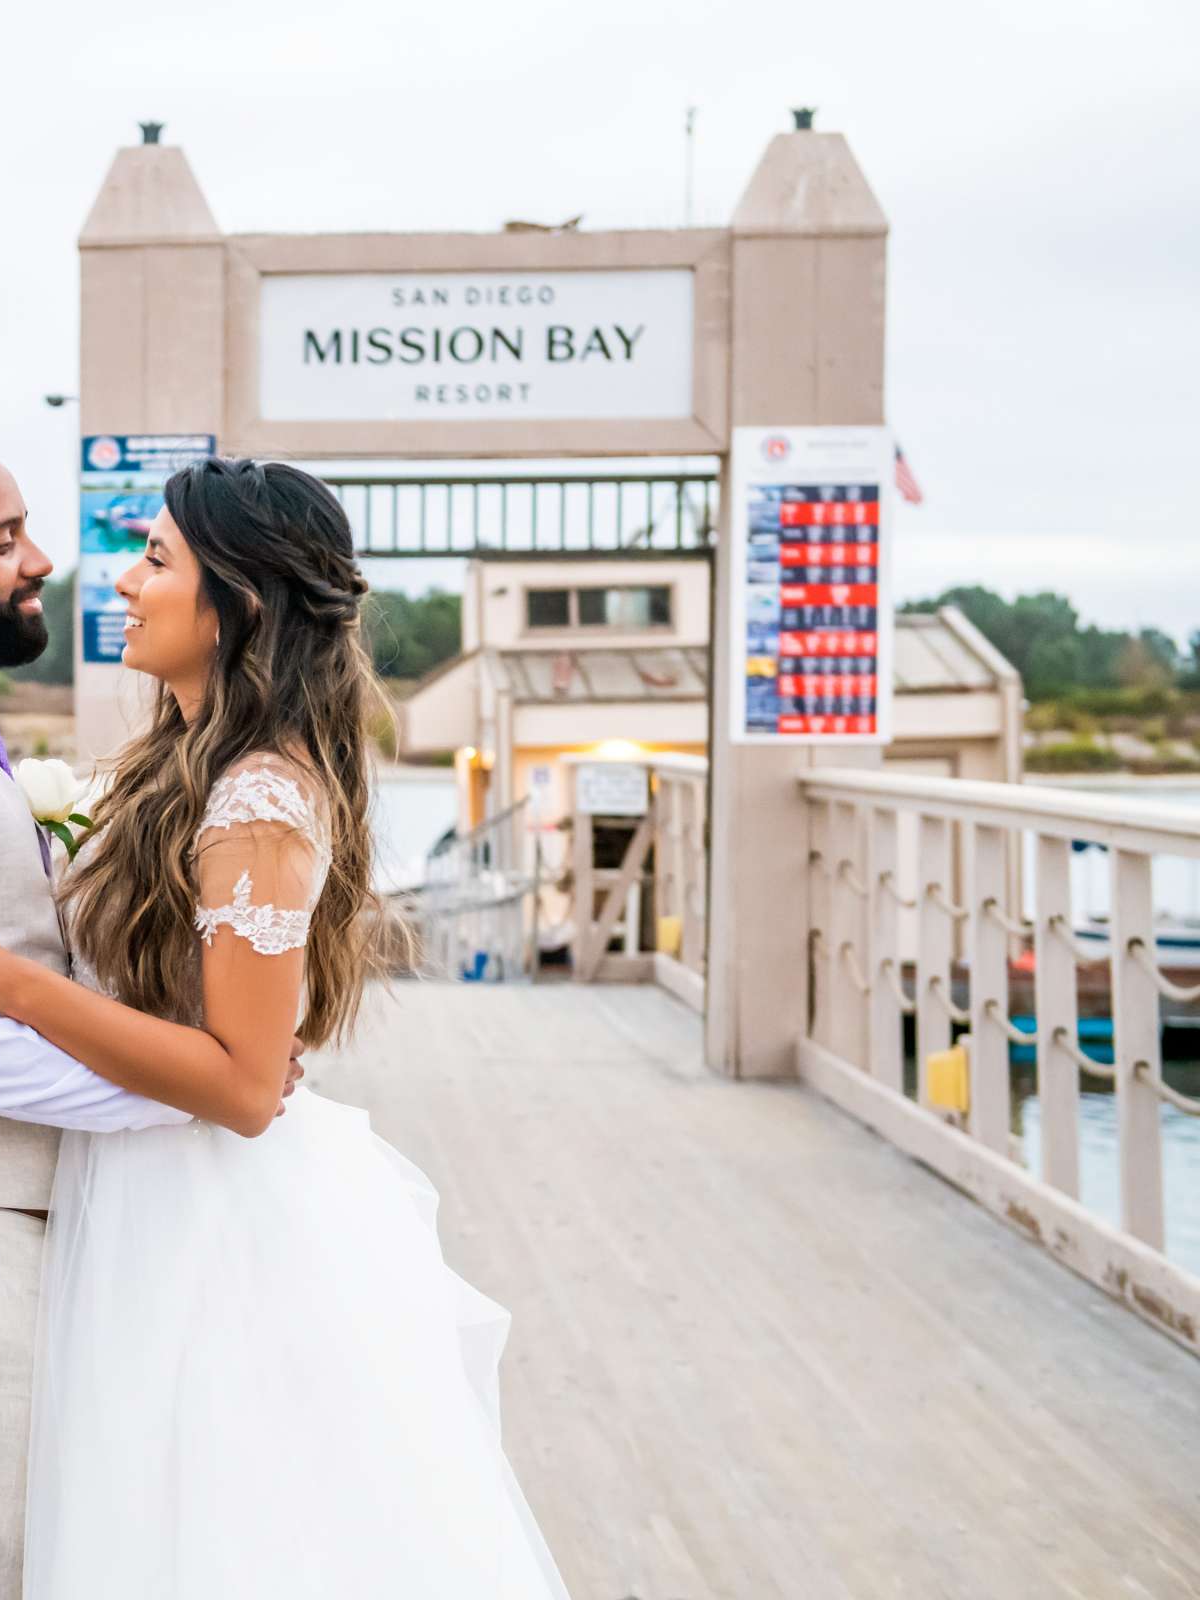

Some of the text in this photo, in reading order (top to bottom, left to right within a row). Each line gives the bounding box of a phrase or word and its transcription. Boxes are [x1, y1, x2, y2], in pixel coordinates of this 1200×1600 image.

[392, 286, 556, 306] SAN DIEGO
[302, 325, 645, 365] MISSION BAY
[414, 384, 532, 403] RESORT
